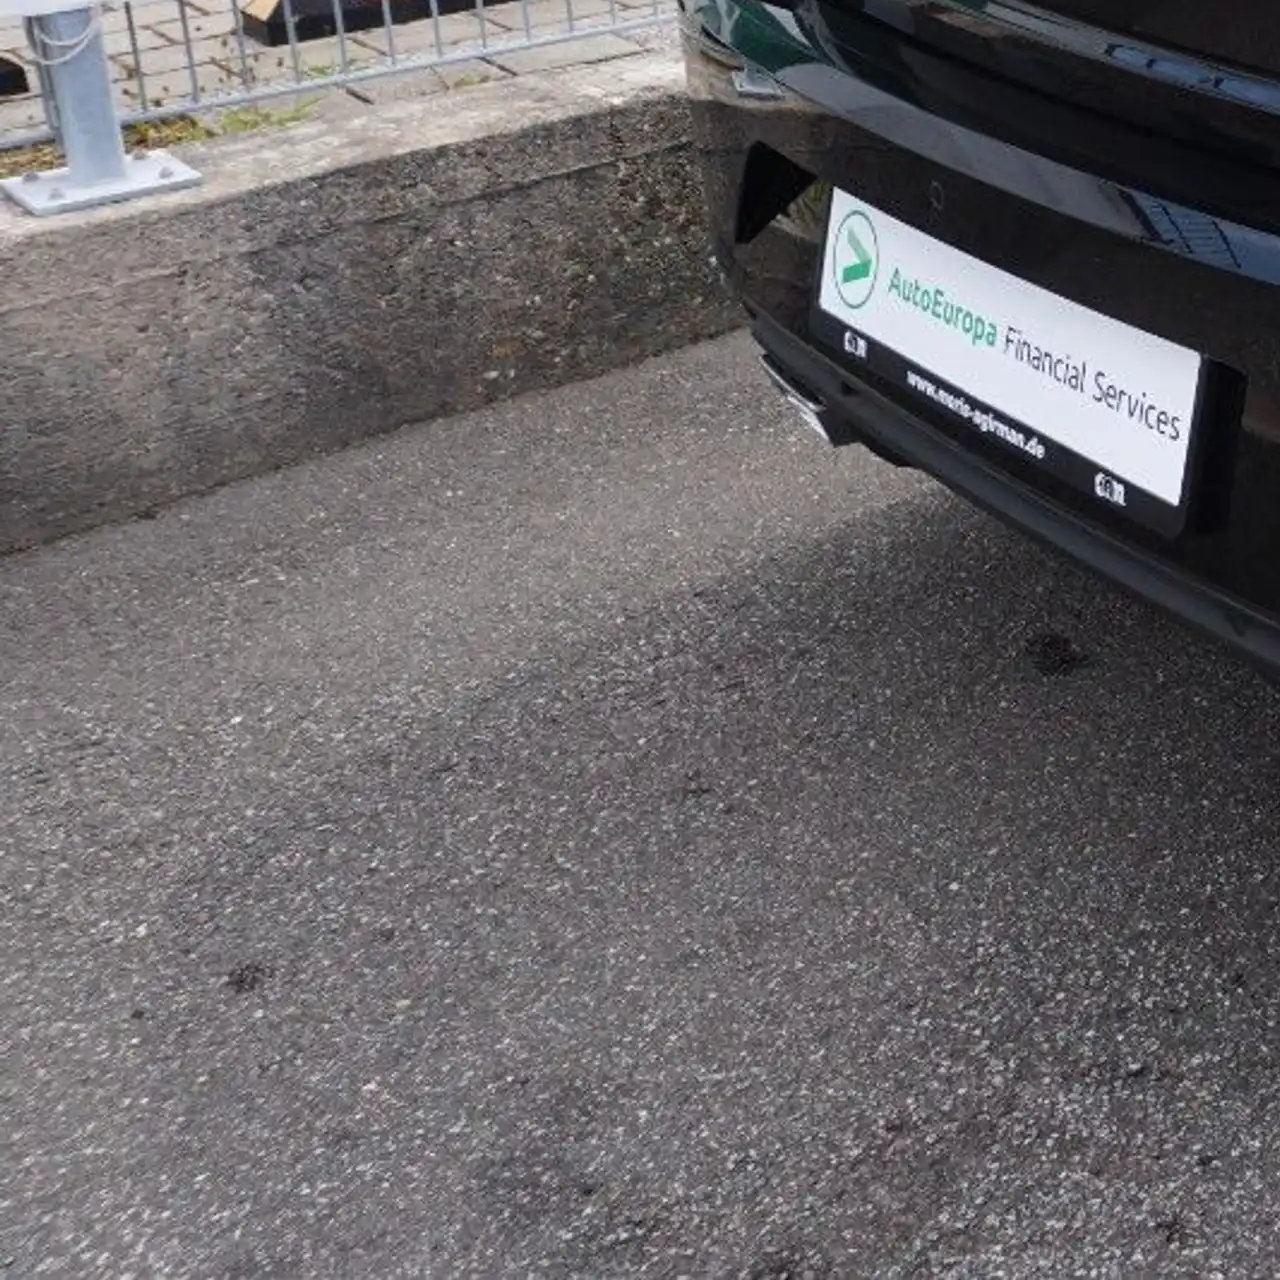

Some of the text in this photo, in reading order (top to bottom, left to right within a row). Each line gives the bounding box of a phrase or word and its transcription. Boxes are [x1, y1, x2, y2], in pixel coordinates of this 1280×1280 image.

[888, 267, 998, 348] AutoEuropa
[1002, 326, 1088, 393] Financial
[1093, 371, 1182, 441] Services
